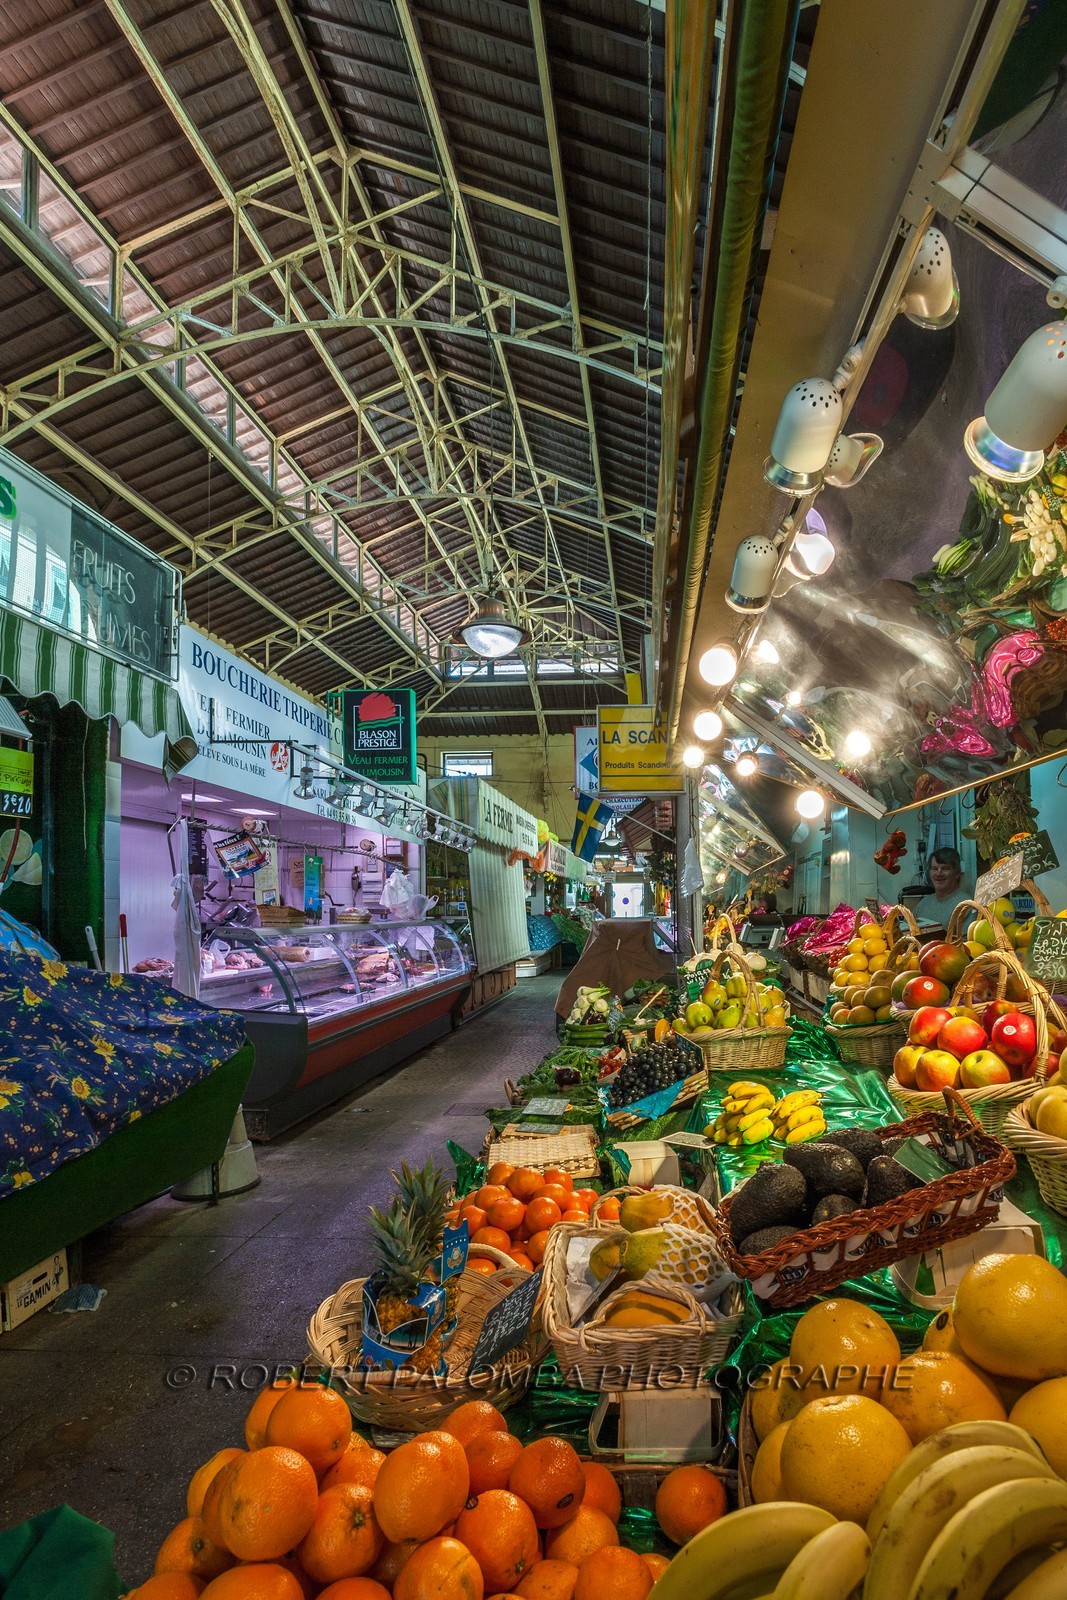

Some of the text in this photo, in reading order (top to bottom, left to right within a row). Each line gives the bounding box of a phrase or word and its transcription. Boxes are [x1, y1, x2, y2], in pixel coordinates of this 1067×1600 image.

[73, 539, 136, 604] FRUITS
[191, 641, 333, 741] BOUCHERIE TRIPERIE
[226, 706, 271, 741] FERMIER
[359, 729, 397, 739] BLASON
[602, 730, 621, 744] LA
[357, 738, 398, 748] PRESTIGE
[221, 753, 240, 768] SOUS
[240, 760, 249, 772] LA
[347, 754, 409, 765] VEAU FERMIER
[605, 761, 636, 769] Produits
[361, 767, 405, 777] LIMOUSIN
[483, 796, 493, 824] LA
[493, 803, 514, 834] FERME
[23, 1279, 51, 1309] GAMIN
